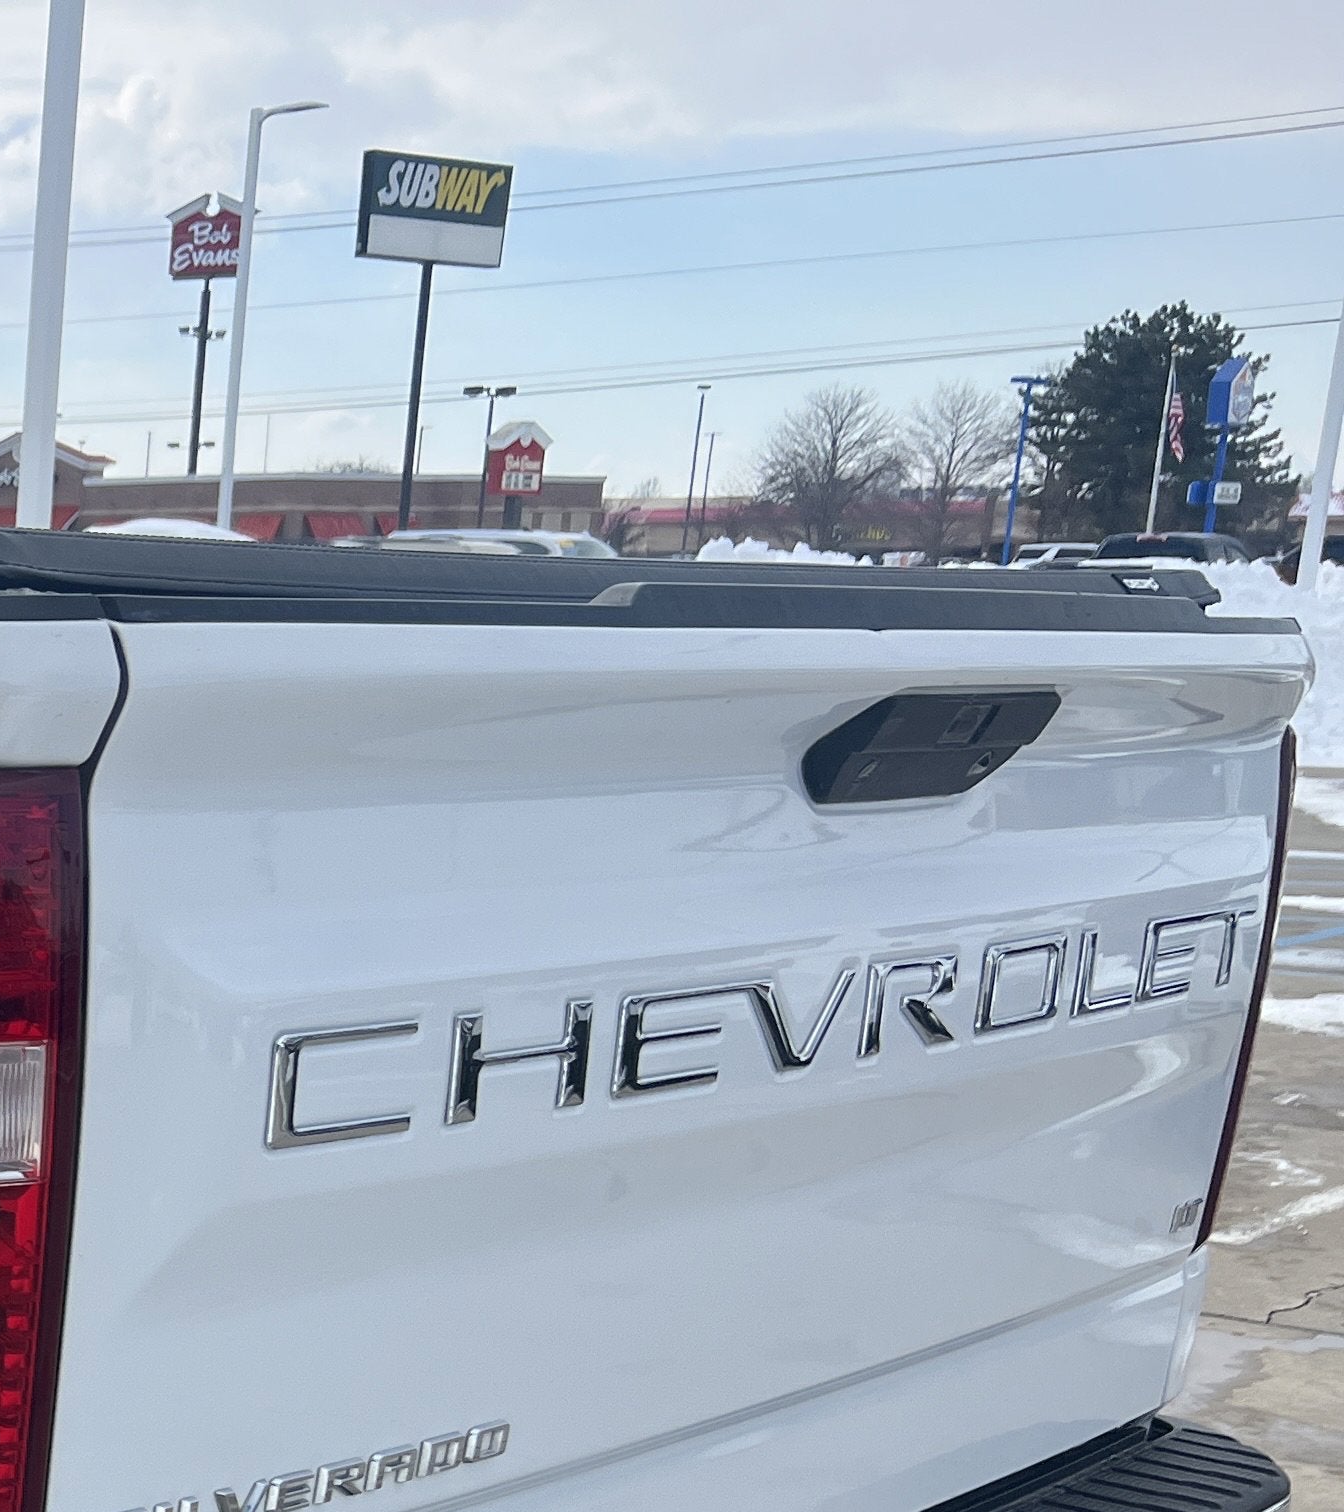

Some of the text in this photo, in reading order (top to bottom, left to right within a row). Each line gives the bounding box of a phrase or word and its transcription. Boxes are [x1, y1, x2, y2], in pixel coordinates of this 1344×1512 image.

[377, 159, 506, 214] SUBWAY
[188, 220, 231, 246] Bob
[173, 242, 240, 273] Evans
[262, 907, 1258, 1152] CHEVROLET
